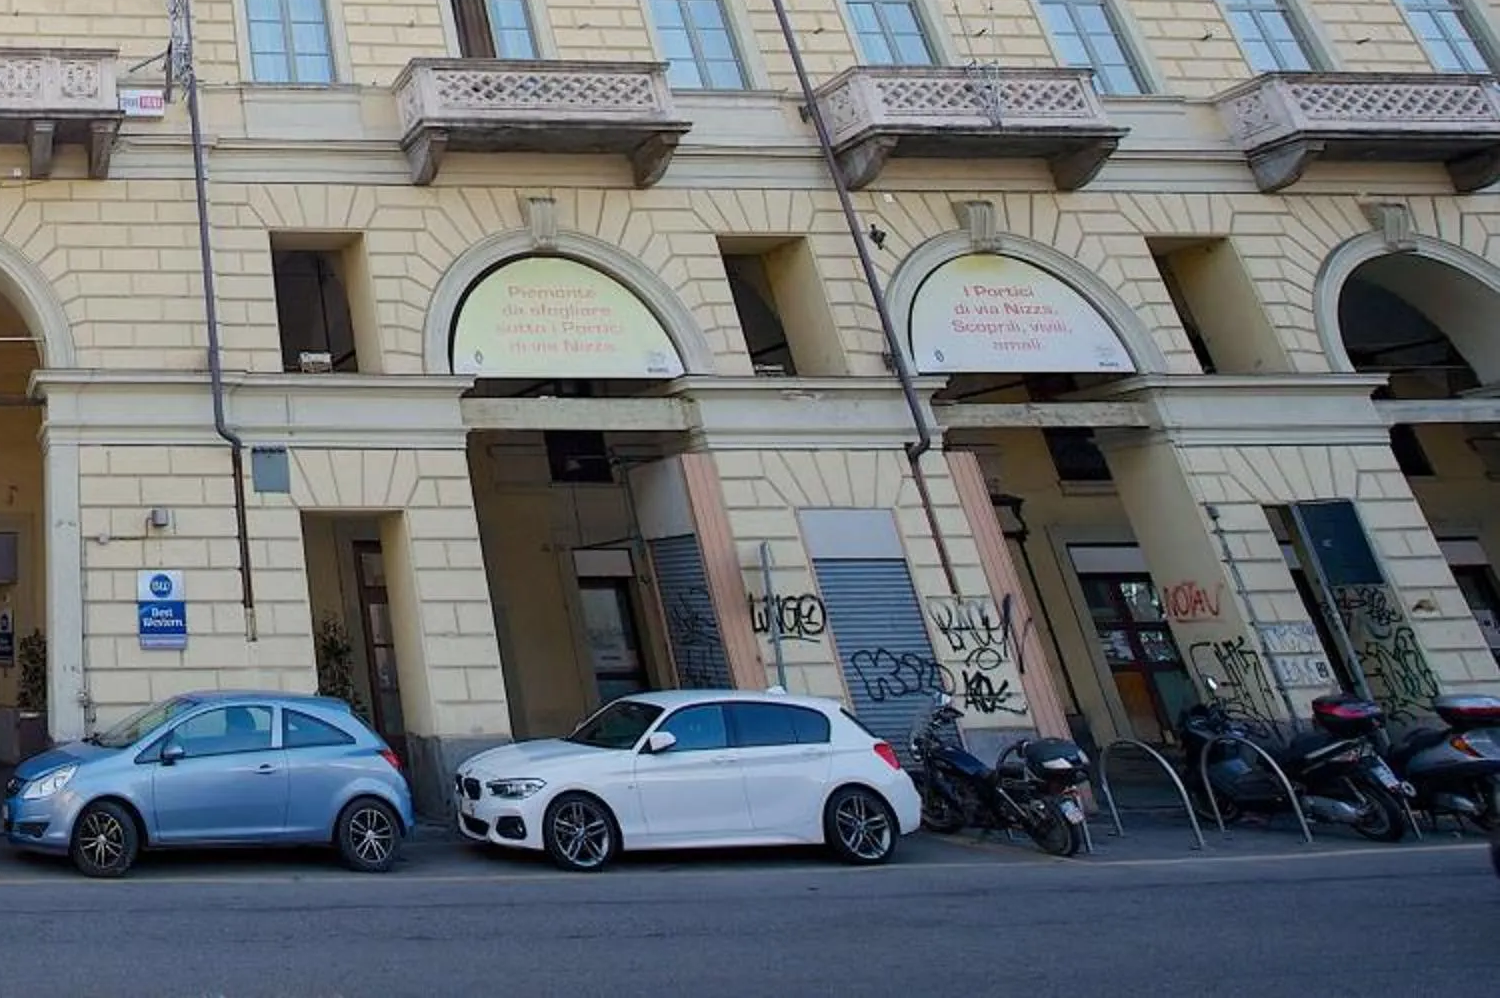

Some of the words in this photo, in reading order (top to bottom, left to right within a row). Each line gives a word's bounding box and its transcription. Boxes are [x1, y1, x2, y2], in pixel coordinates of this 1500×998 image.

[508, 285, 596, 299] Piemonte
[973, 285, 1034, 297] Portici
[955, 303, 970, 314] di
[974, 304, 999, 314] via
[151, 607, 173, 617] Best
[143, 618, 183, 627] Western
